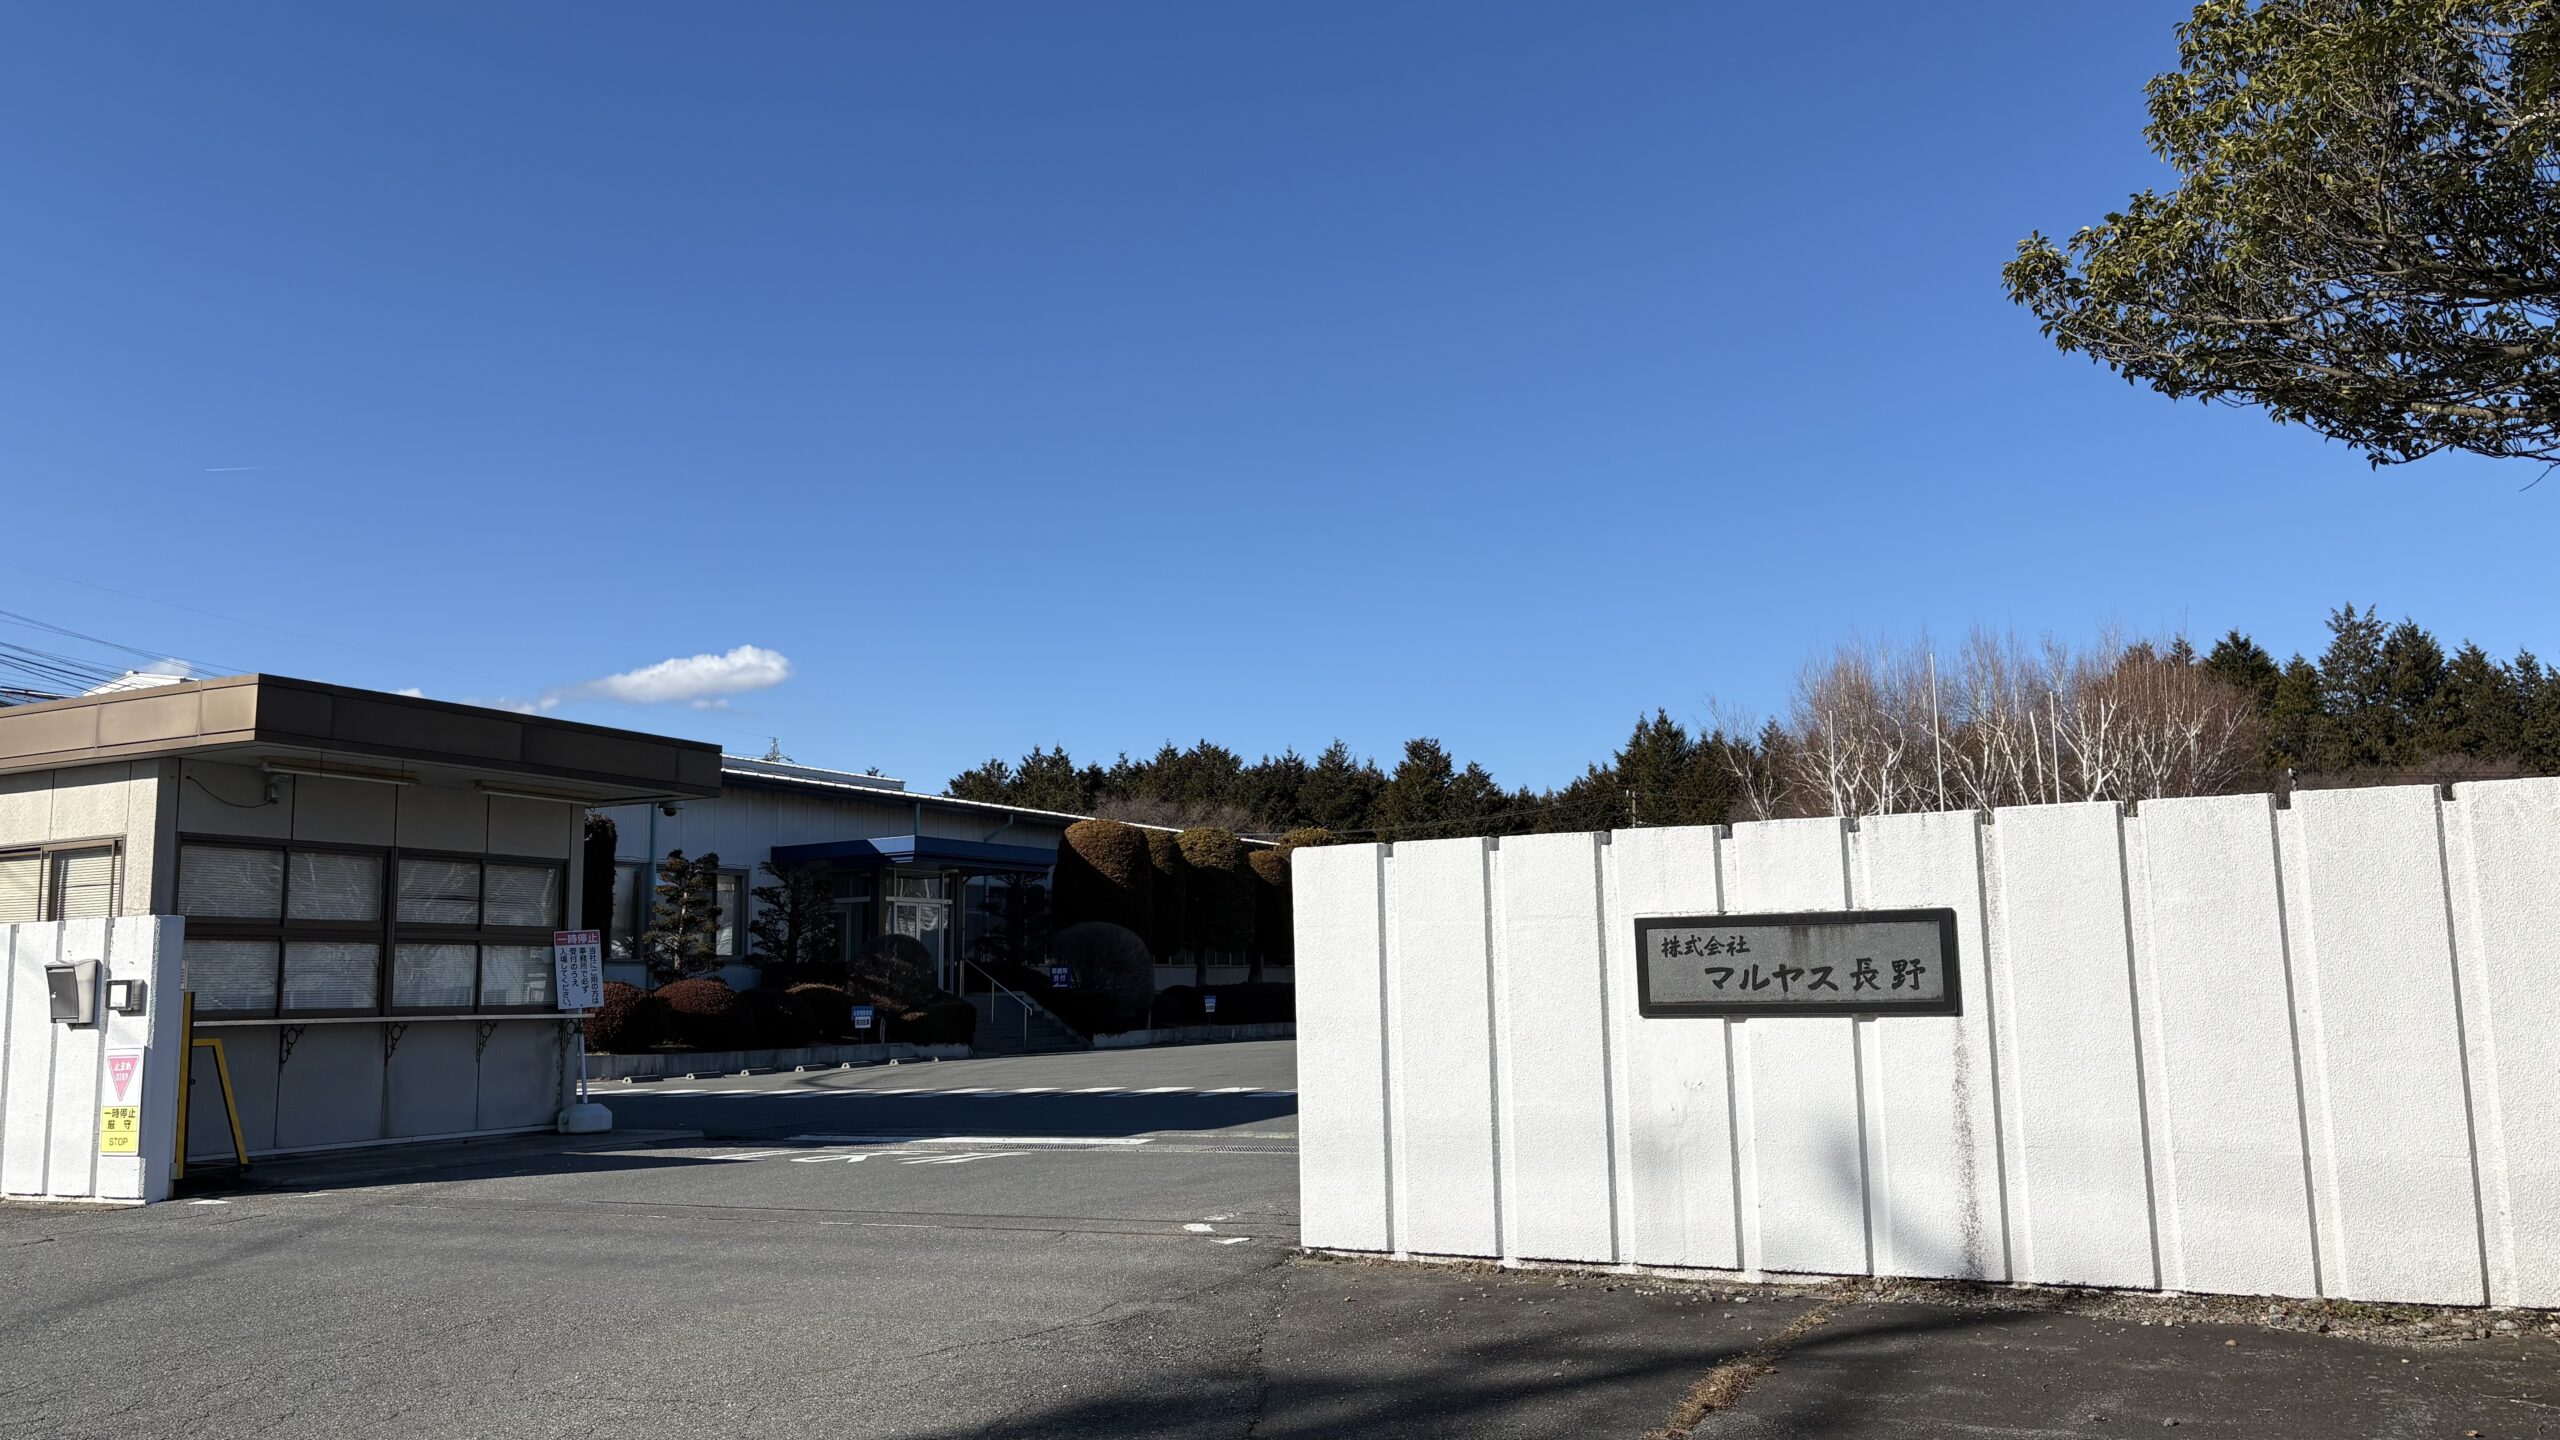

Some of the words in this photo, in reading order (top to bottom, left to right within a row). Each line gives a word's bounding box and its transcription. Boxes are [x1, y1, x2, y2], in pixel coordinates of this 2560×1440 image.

[556, 933, 598, 944] 一時停止
[1661, 935, 1750, 958] 株式会社
[569, 947, 579, 987] 受付のうえ
[579, 946, 589, 994] 事務所で必ず
[589, 946, 600, 1005] 当社にご用の方は
[1704, 957, 1926, 992] マルヤス長野
[116, 1073, 128, 1081] STOP
[104, 1108, 136, 1118] 一時停止
[109, 1138, 128, 1146] STOP
